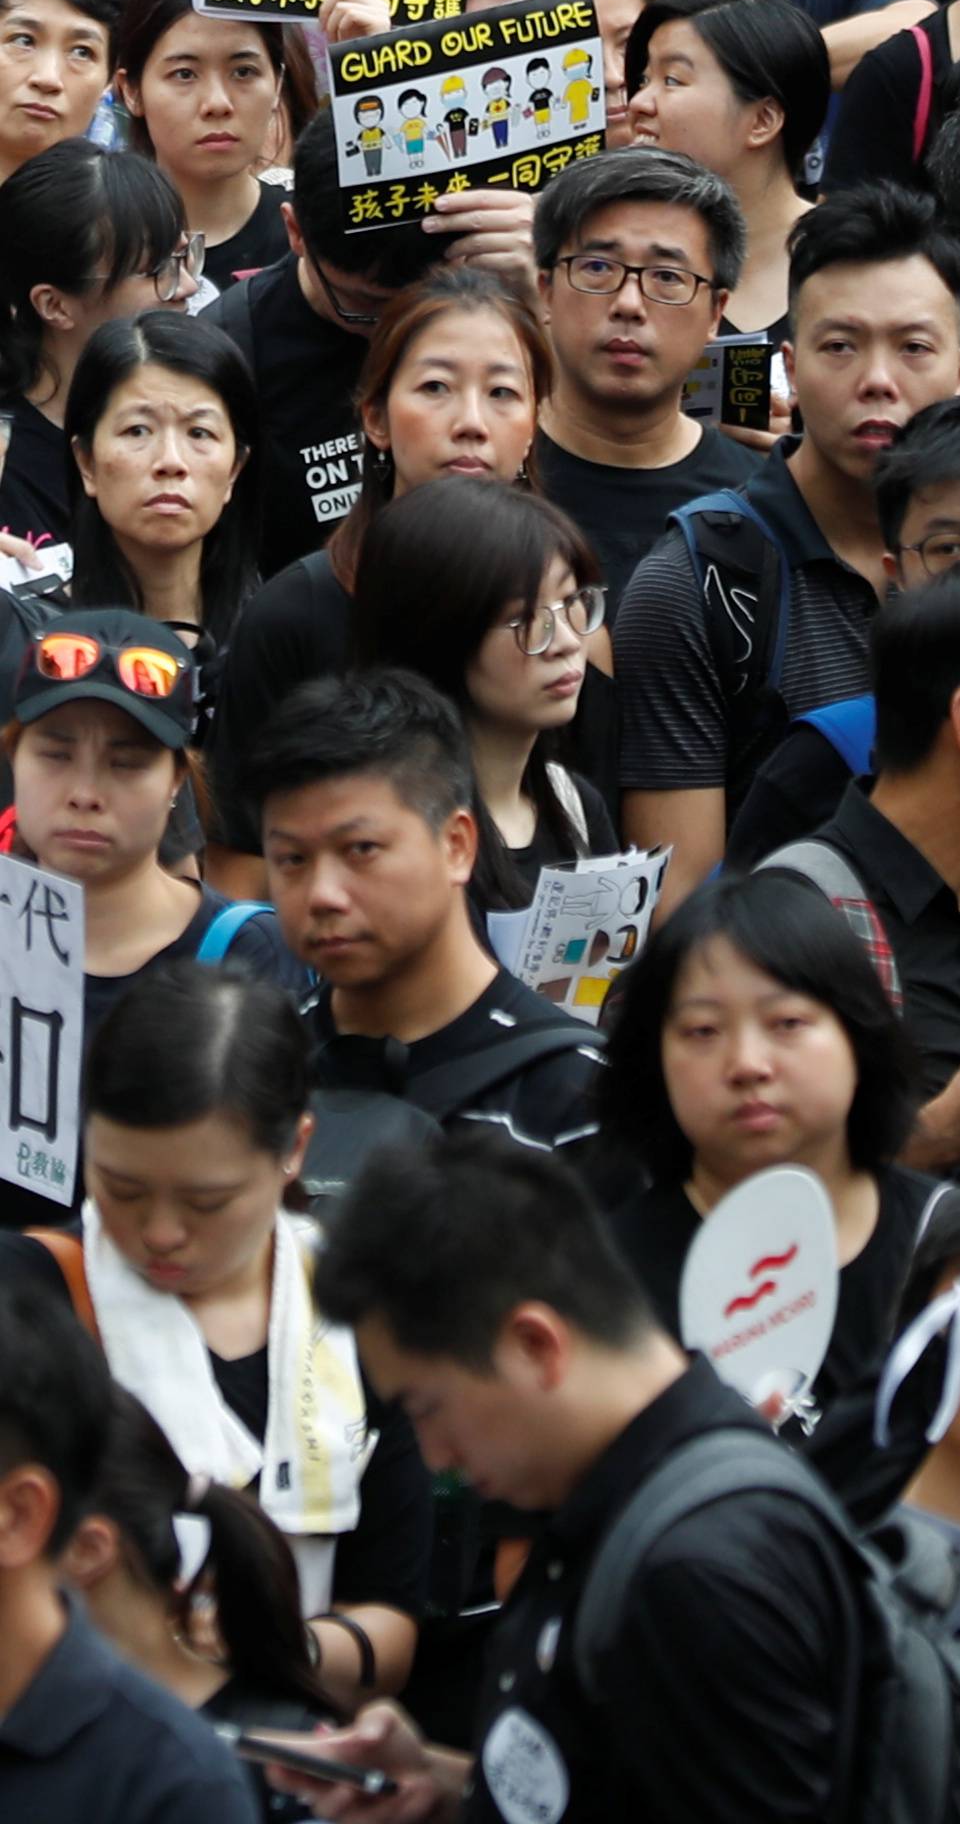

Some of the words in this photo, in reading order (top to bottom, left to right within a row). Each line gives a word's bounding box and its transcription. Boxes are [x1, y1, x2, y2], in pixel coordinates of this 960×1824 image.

[340, 39, 433, 82] GUARD
[441, 22, 494, 57] OUR
[499, 0, 593, 45] FUTURE
[299, 433, 359, 464] THERE
[305, 458, 349, 490] ON
[14, 879, 71, 967] 代
